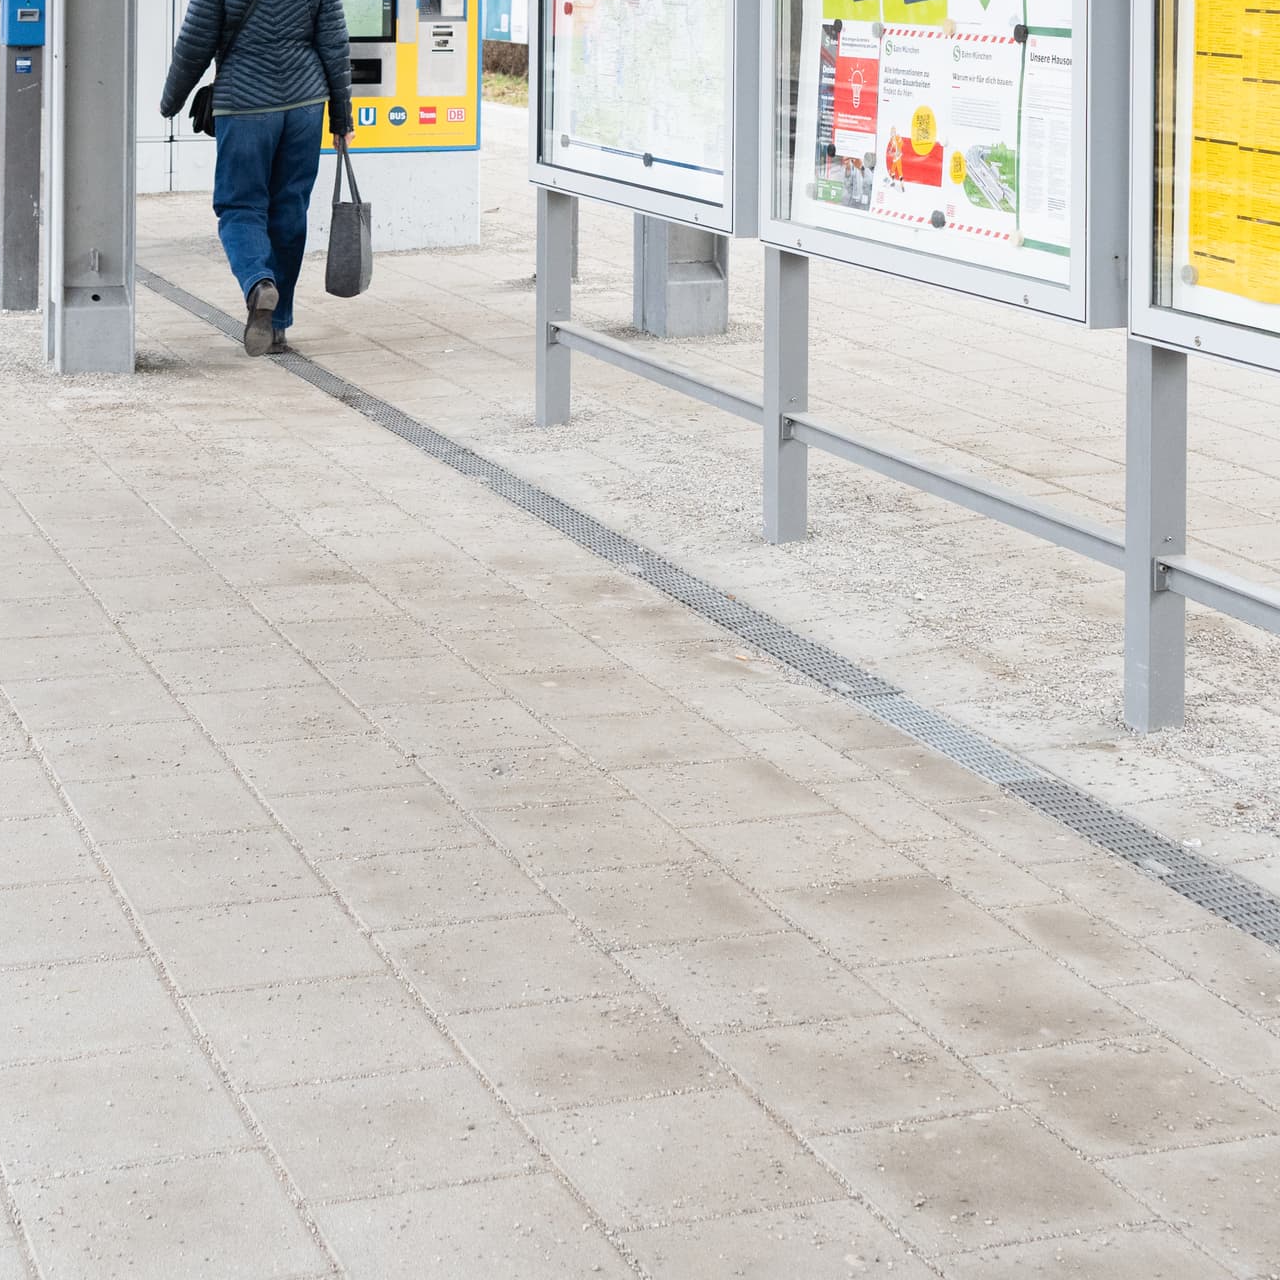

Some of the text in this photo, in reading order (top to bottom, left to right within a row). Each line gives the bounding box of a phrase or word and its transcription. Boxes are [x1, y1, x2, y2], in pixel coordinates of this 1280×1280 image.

[1030, 52, 1050, 64] Unsere
[361, 108, 374, 125] U
[389, 112, 406, 120] BUS
[449, 110, 463, 120] DB
